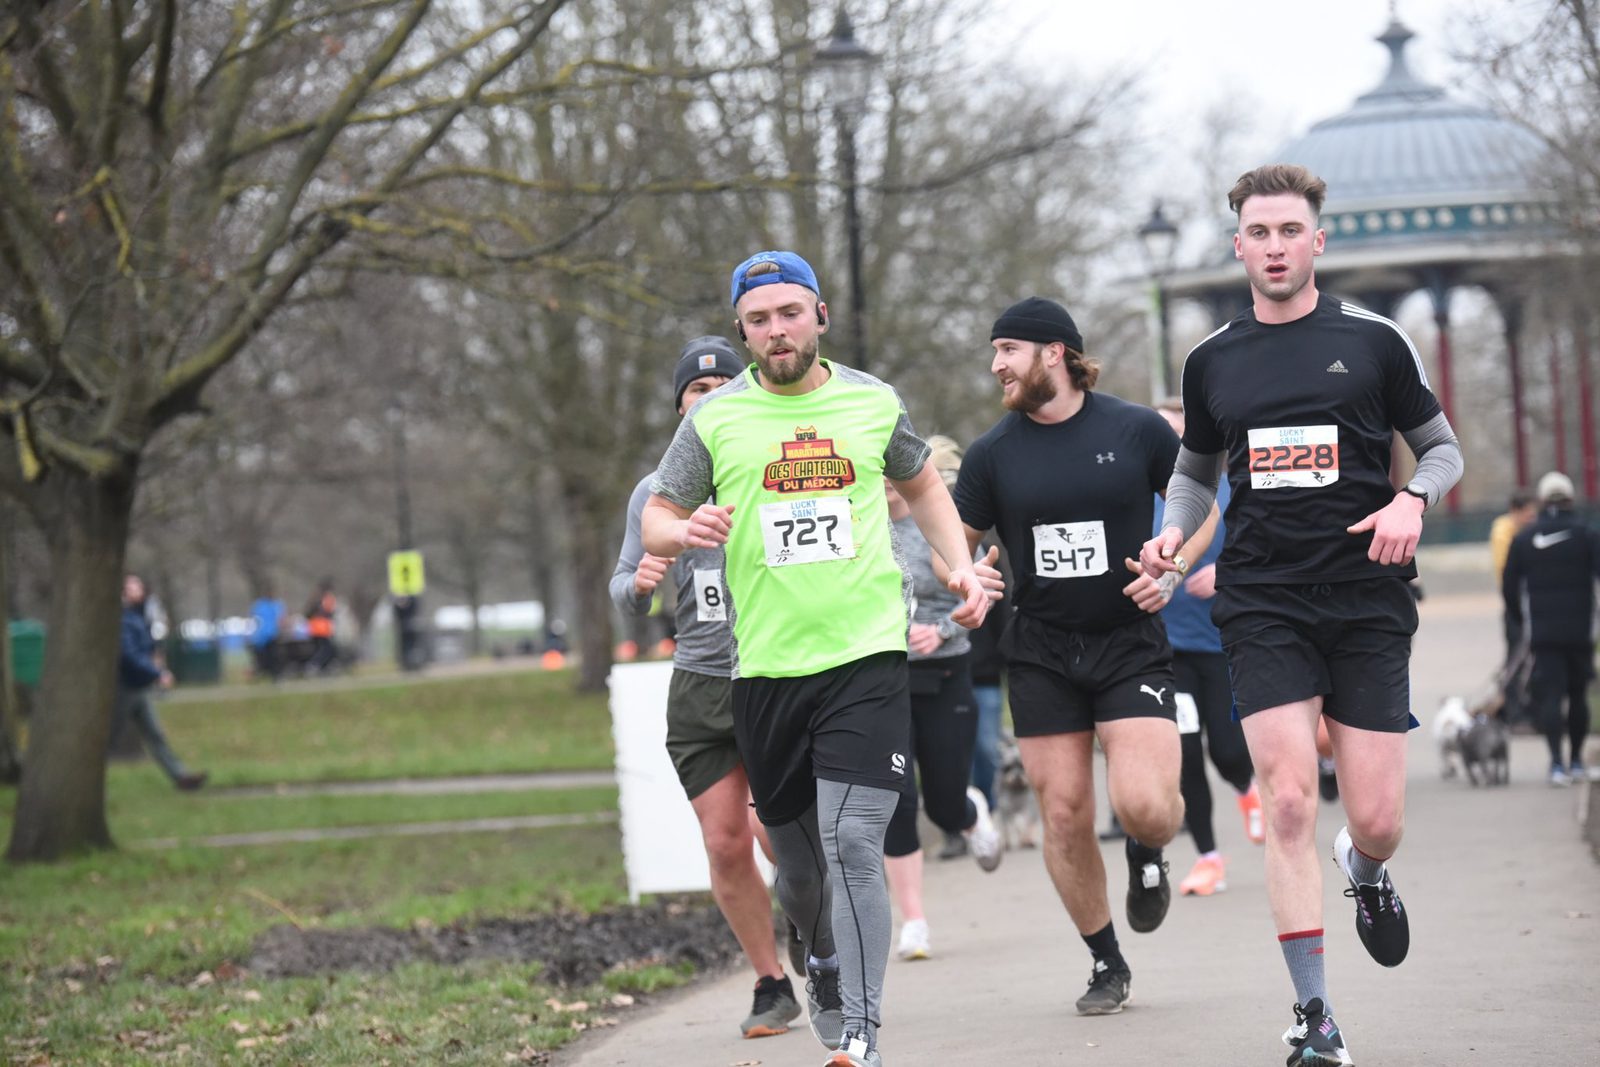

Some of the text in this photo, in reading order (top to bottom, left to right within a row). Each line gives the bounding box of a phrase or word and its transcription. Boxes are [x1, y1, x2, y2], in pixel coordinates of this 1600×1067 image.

[1279, 428, 1305, 437] LUCKY
[1279, 436, 1305, 445] SAINT
[1252, 443, 1335, 472] 2228
[768, 459, 849, 481] DES CHATEAUX
[783, 476, 840, 491] DU MÉDOC
[790, 499, 818, 510] LUCKY
[791, 508, 818, 519] SAINT
[773, 514, 839, 548] 727
[1040, 547, 1096, 572] 547
[704, 585, 724, 607] 8
